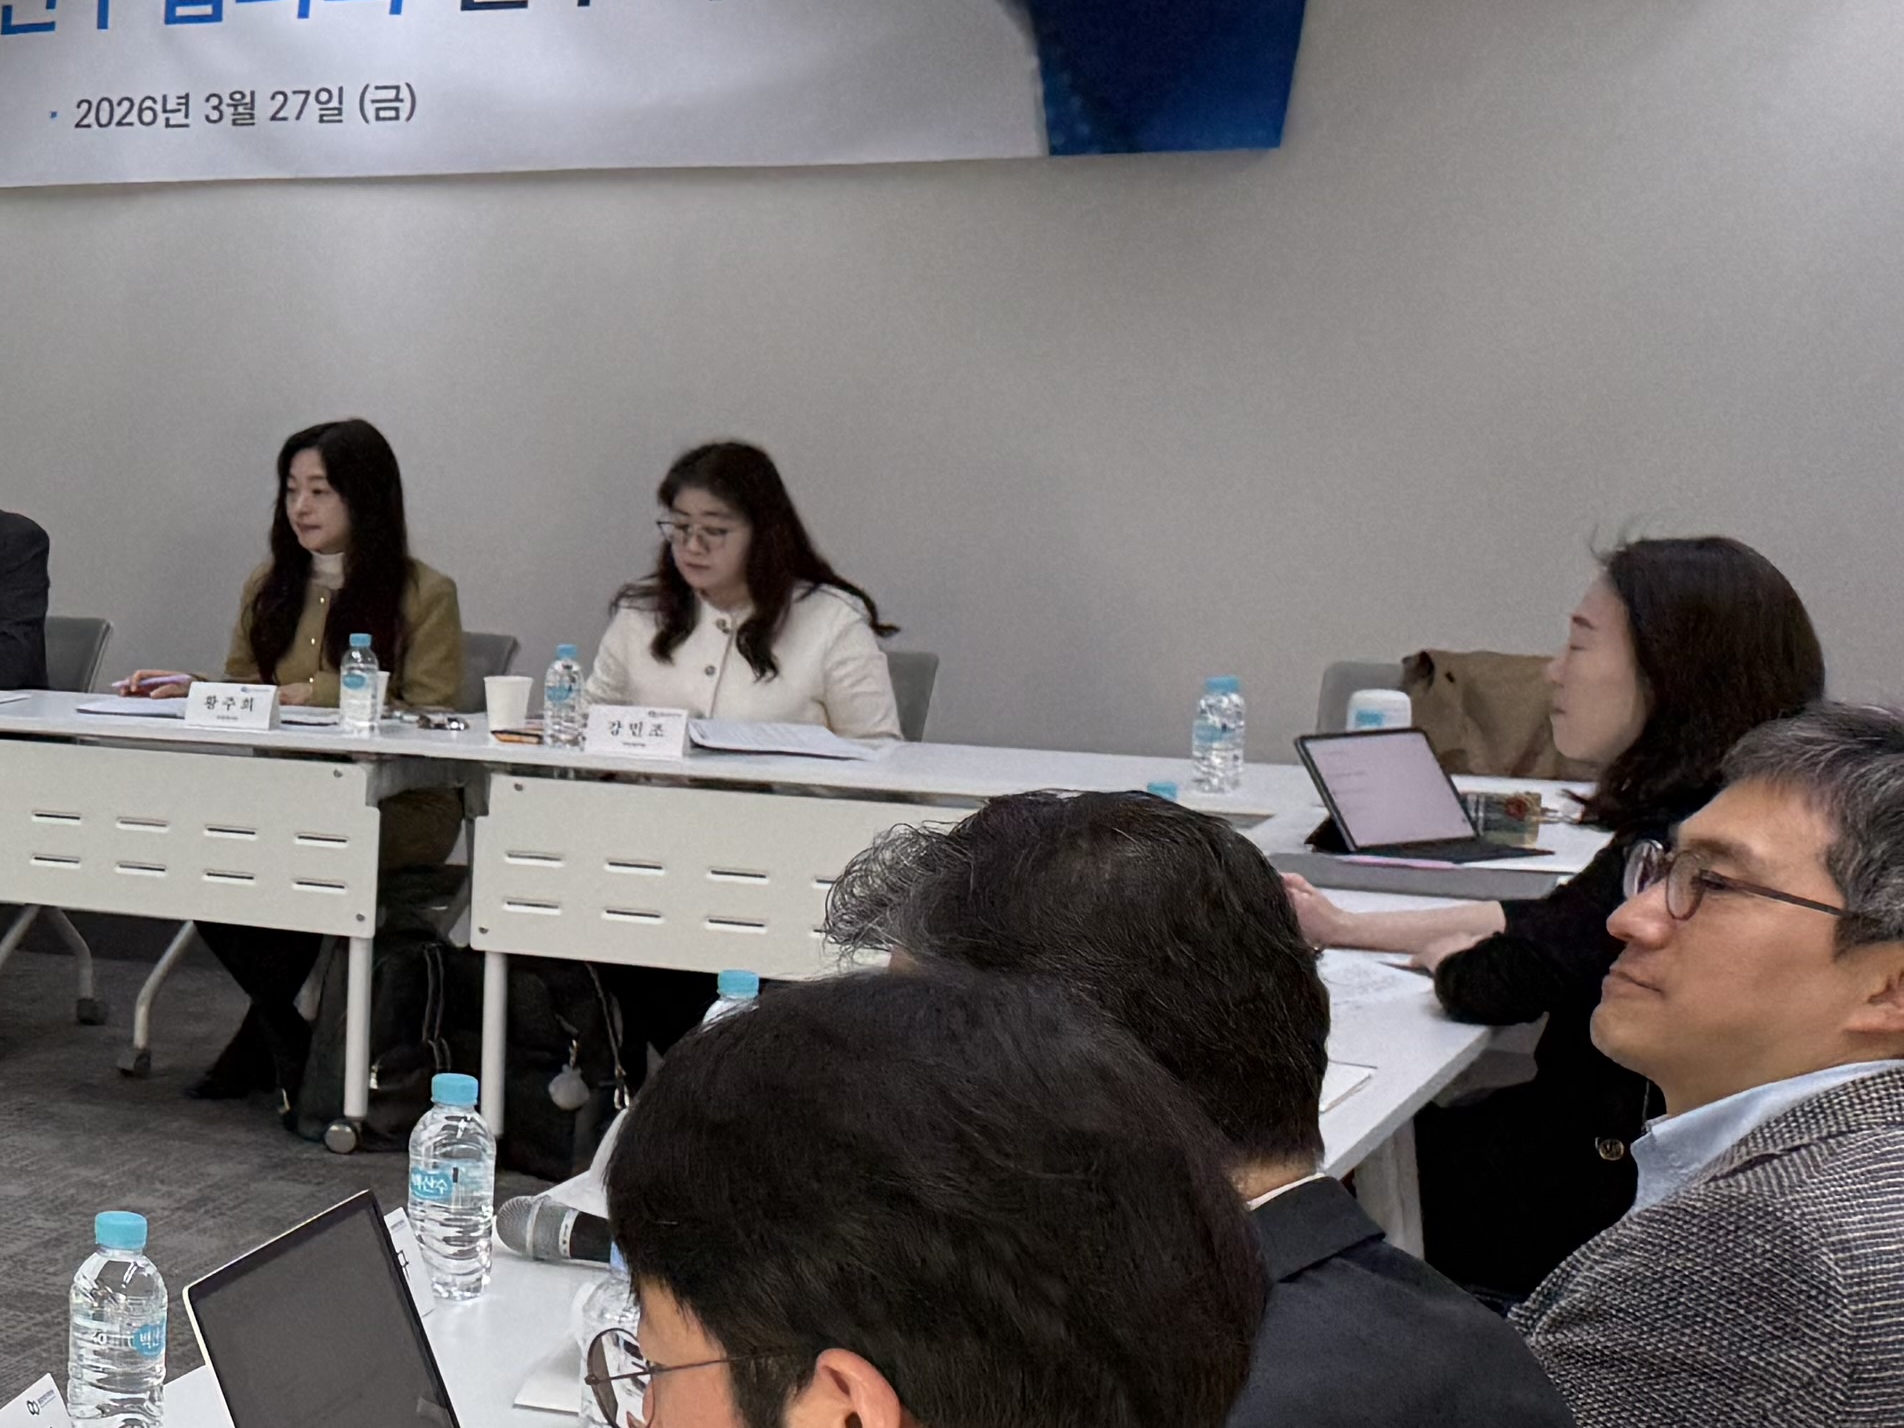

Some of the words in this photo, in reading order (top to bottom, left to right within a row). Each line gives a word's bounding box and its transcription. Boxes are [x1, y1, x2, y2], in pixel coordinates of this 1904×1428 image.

[74, 91, 193, 131] 2026년
[204, 89, 258, 127] 3월
[268, 85, 345, 125] 27일
[357, 82, 418, 123] (금)
